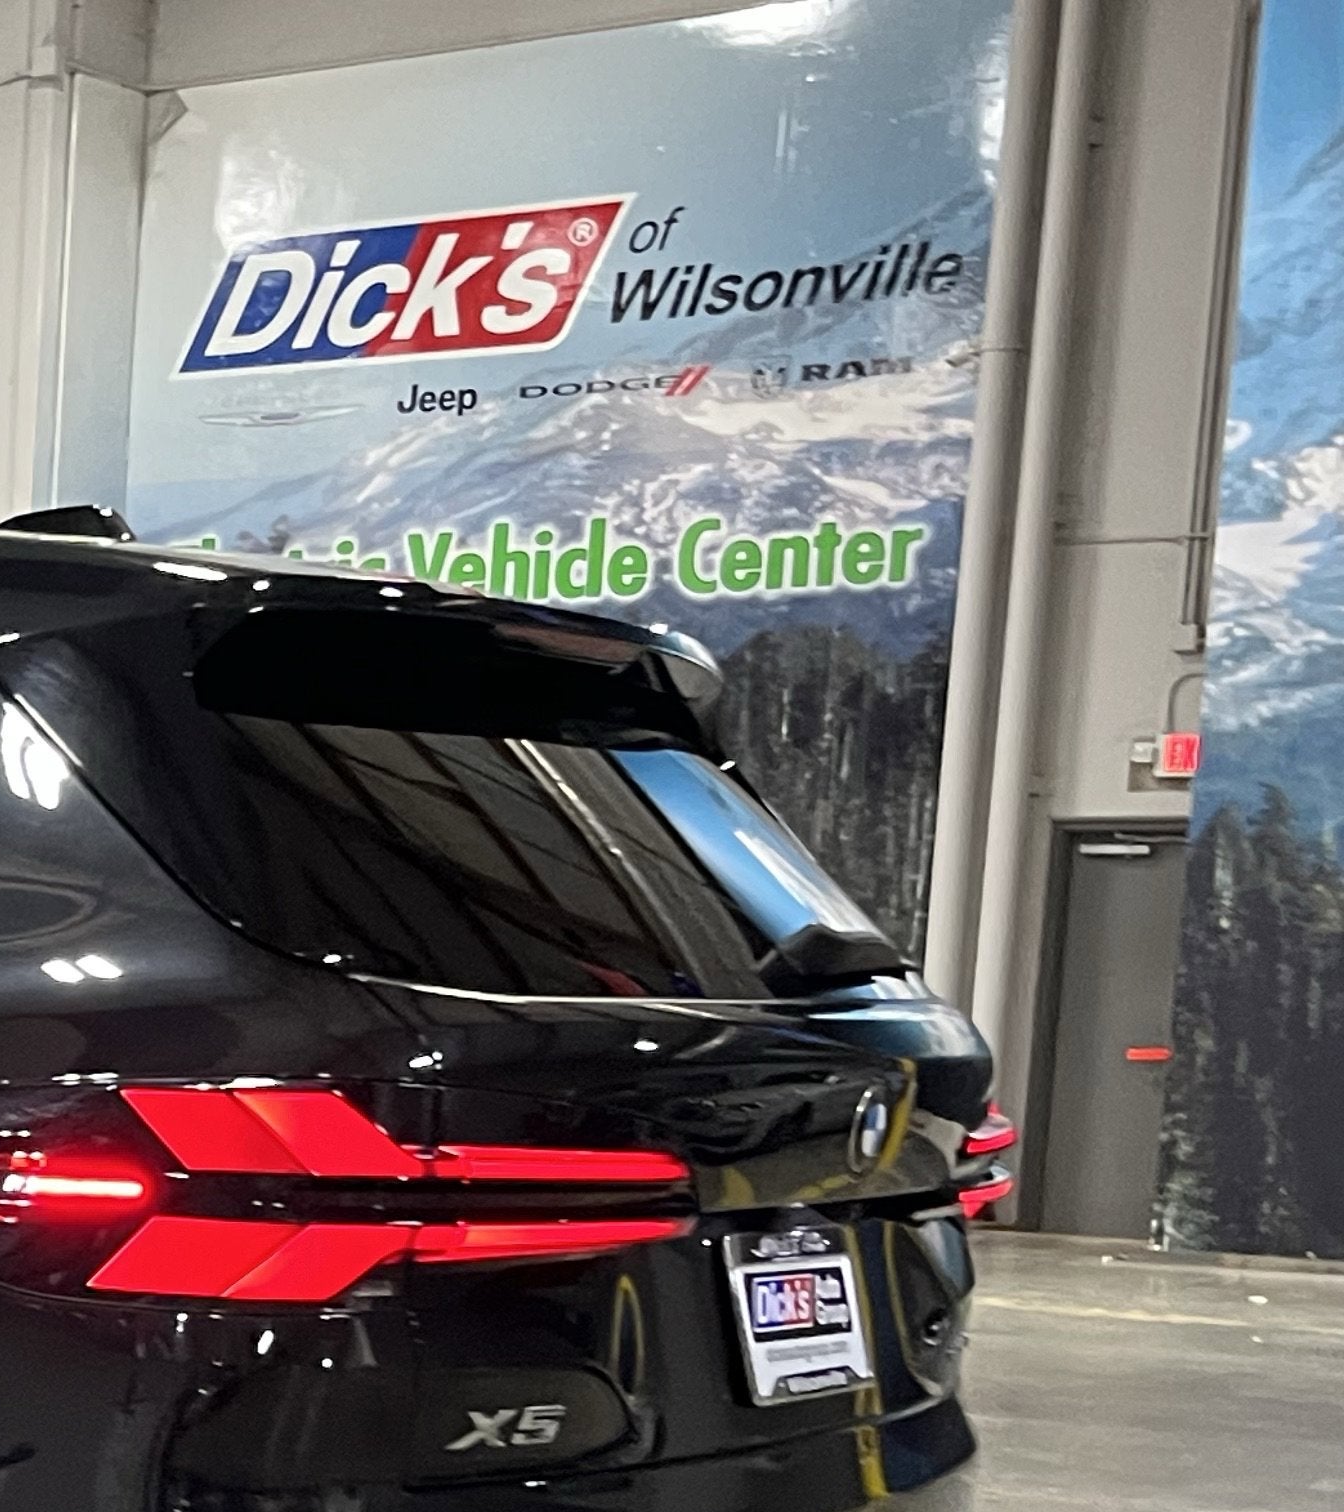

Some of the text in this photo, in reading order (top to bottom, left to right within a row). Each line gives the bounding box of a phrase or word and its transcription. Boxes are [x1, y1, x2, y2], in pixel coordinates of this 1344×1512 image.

[628, 206, 686, 254] of
[610, 240, 964, 324] Wilsonville
[518, 373, 682, 400] DODGE
[800, 356, 914, 383] RAM
[396, 384, 478, 417] Jeep
[408, 518, 648, 598] Vehicle
[677, 517, 925, 594] Center
[443, 1404, 568, 1451] X5
